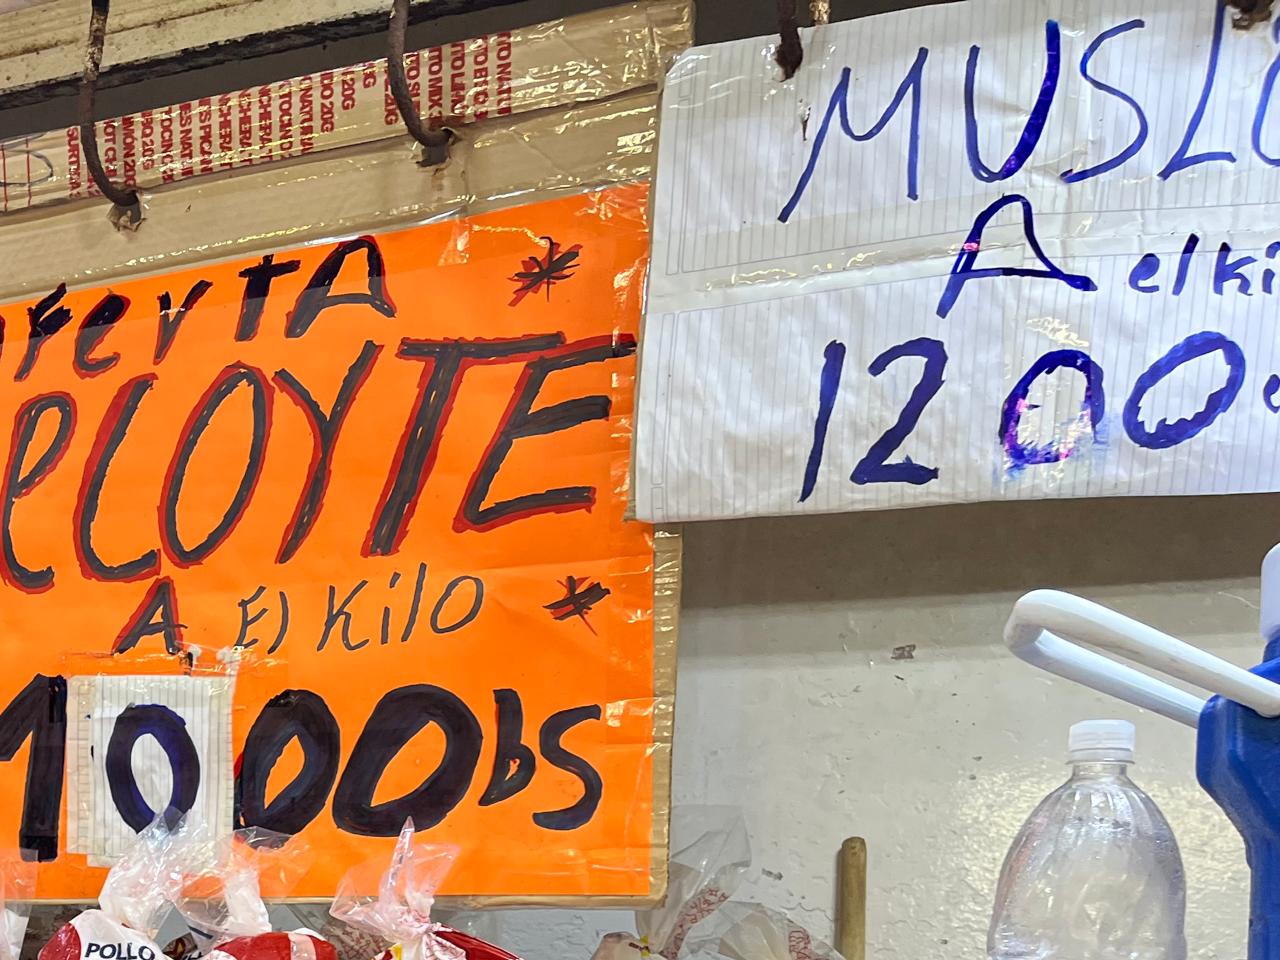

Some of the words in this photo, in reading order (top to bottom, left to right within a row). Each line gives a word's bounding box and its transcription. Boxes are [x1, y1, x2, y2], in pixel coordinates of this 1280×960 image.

[935, 193, 1098, 319] A
[797, 330, 1247, 503] 1200
[110, 577, 188, 655] A
